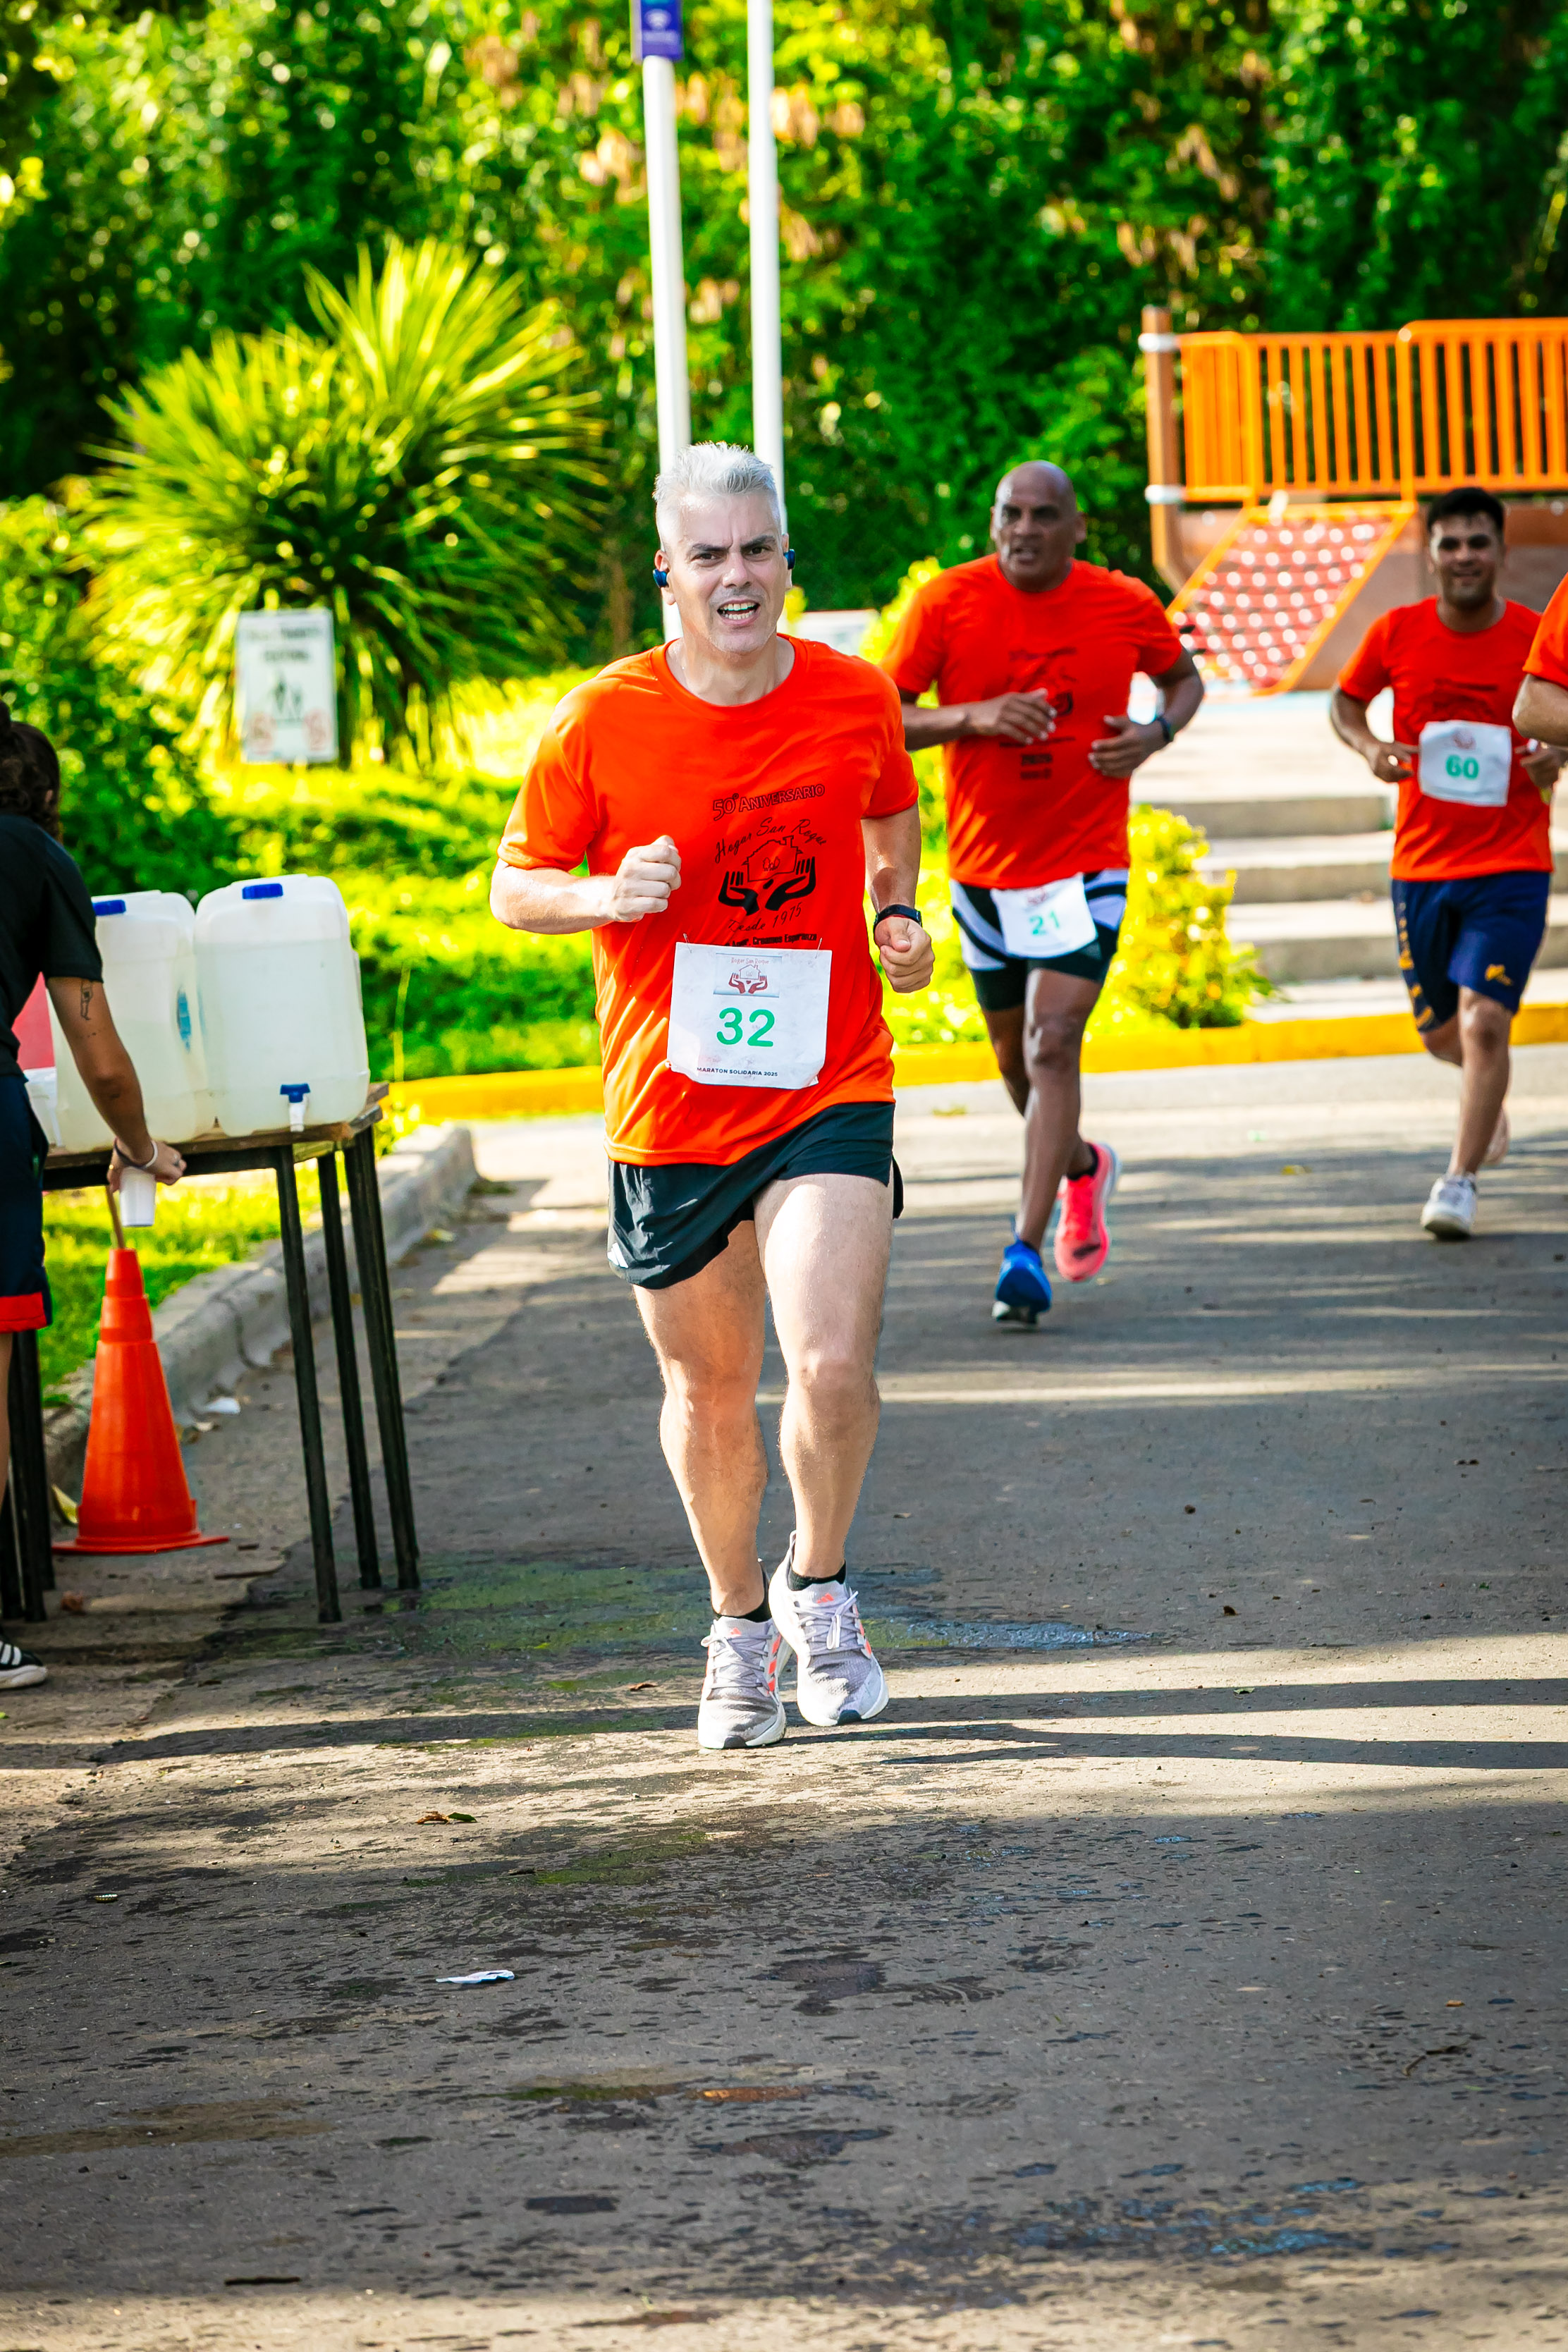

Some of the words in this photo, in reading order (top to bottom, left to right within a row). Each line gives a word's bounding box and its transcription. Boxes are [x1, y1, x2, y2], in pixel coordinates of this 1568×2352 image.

[1445, 755, 1478, 780] 60
[739, 784, 825, 812] ANIVERSARIO
[715, 833, 752, 864] Hogar
[757, 817, 786, 836] San
[791, 819, 826, 845] Roque
[728, 918, 766, 931] Desde
[773, 902, 803, 928] 1975
[1029, 910, 1060, 936] 21
[716, 1007, 775, 1047] 32
